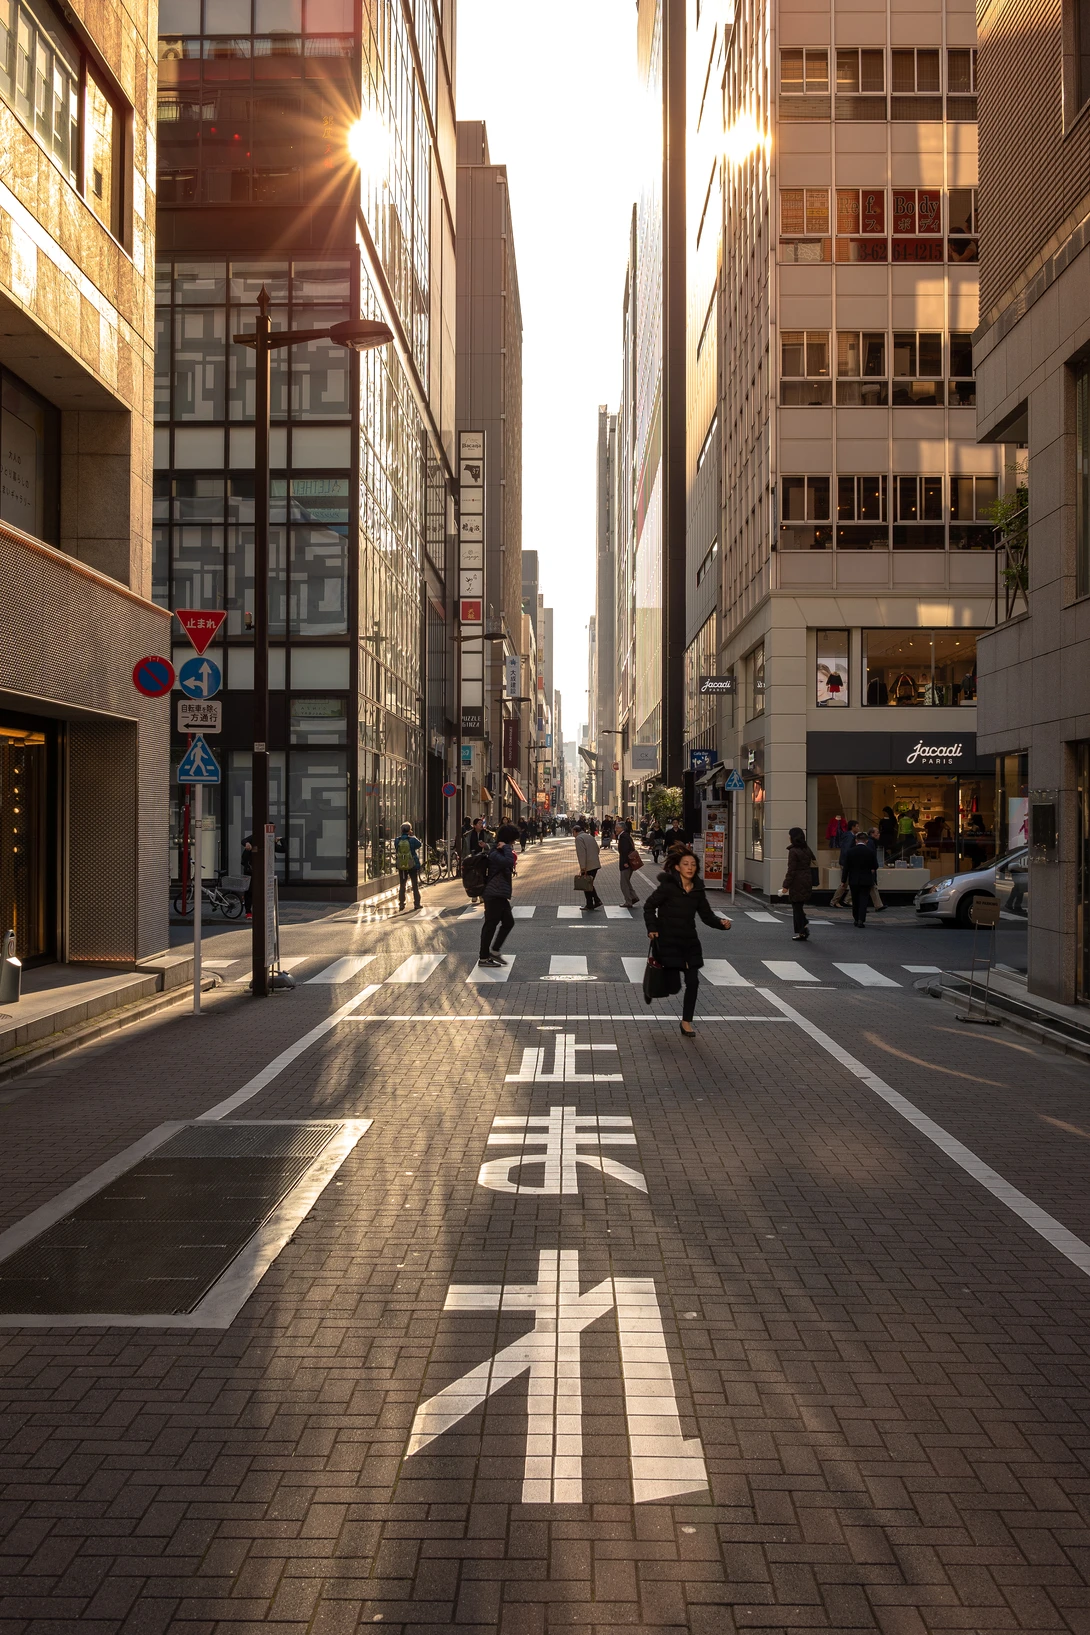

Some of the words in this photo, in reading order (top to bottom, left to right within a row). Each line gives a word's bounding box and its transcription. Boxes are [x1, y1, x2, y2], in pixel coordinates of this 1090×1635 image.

[894, 195, 939, 218] Body
[8, 450, 22, 465] 大人の
[0, 485, 31, 506] まいギャラリー
[186, 618, 217, 629] 止まれ
[701, 678, 731, 692] jacadi
[181, 704, 218, 713] 自転車を除く
[181, 713, 218, 723] 一方通行
[906, 740, 963, 764] jacadi
[404, 1033, 710, 1504] 止まれ
